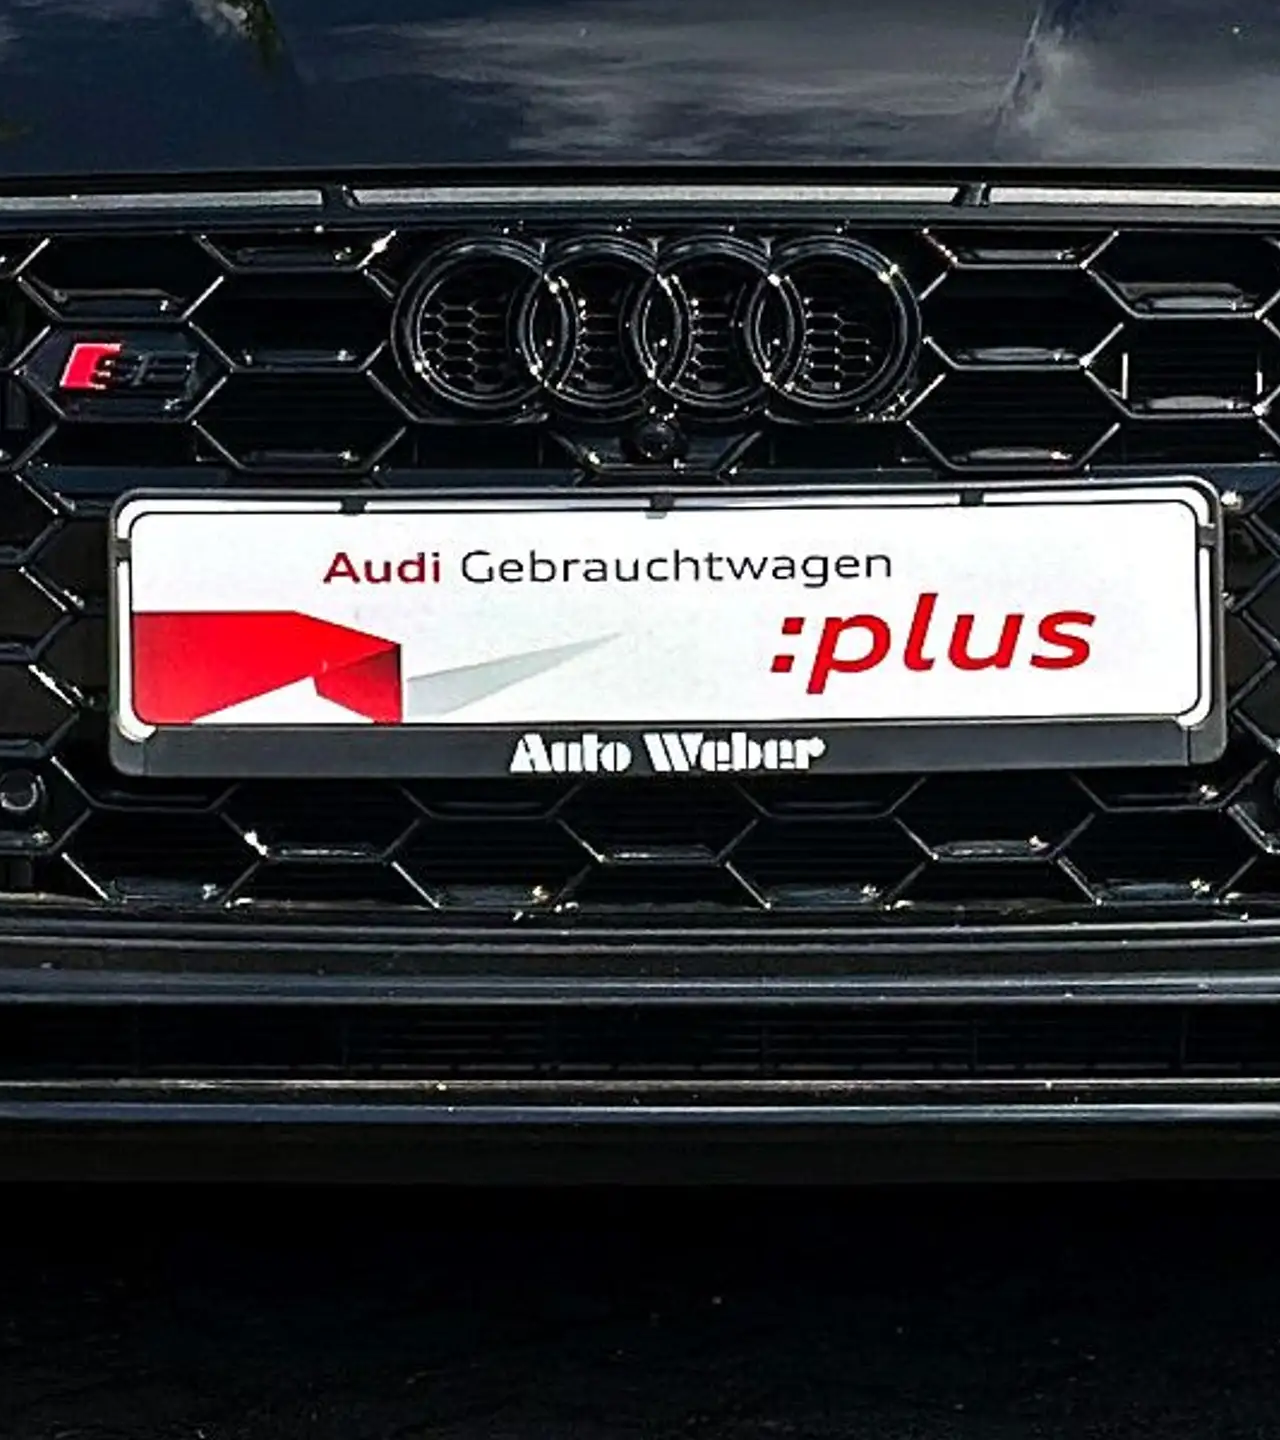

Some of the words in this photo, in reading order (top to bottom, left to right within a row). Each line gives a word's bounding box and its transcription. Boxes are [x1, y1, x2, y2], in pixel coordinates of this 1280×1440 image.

[323, 551, 440, 584] Audi
[461, 549, 892, 589] Gebrauchtwagen
[510, 733, 632, 773] Auto
[643, 731, 826, 772] Weber
